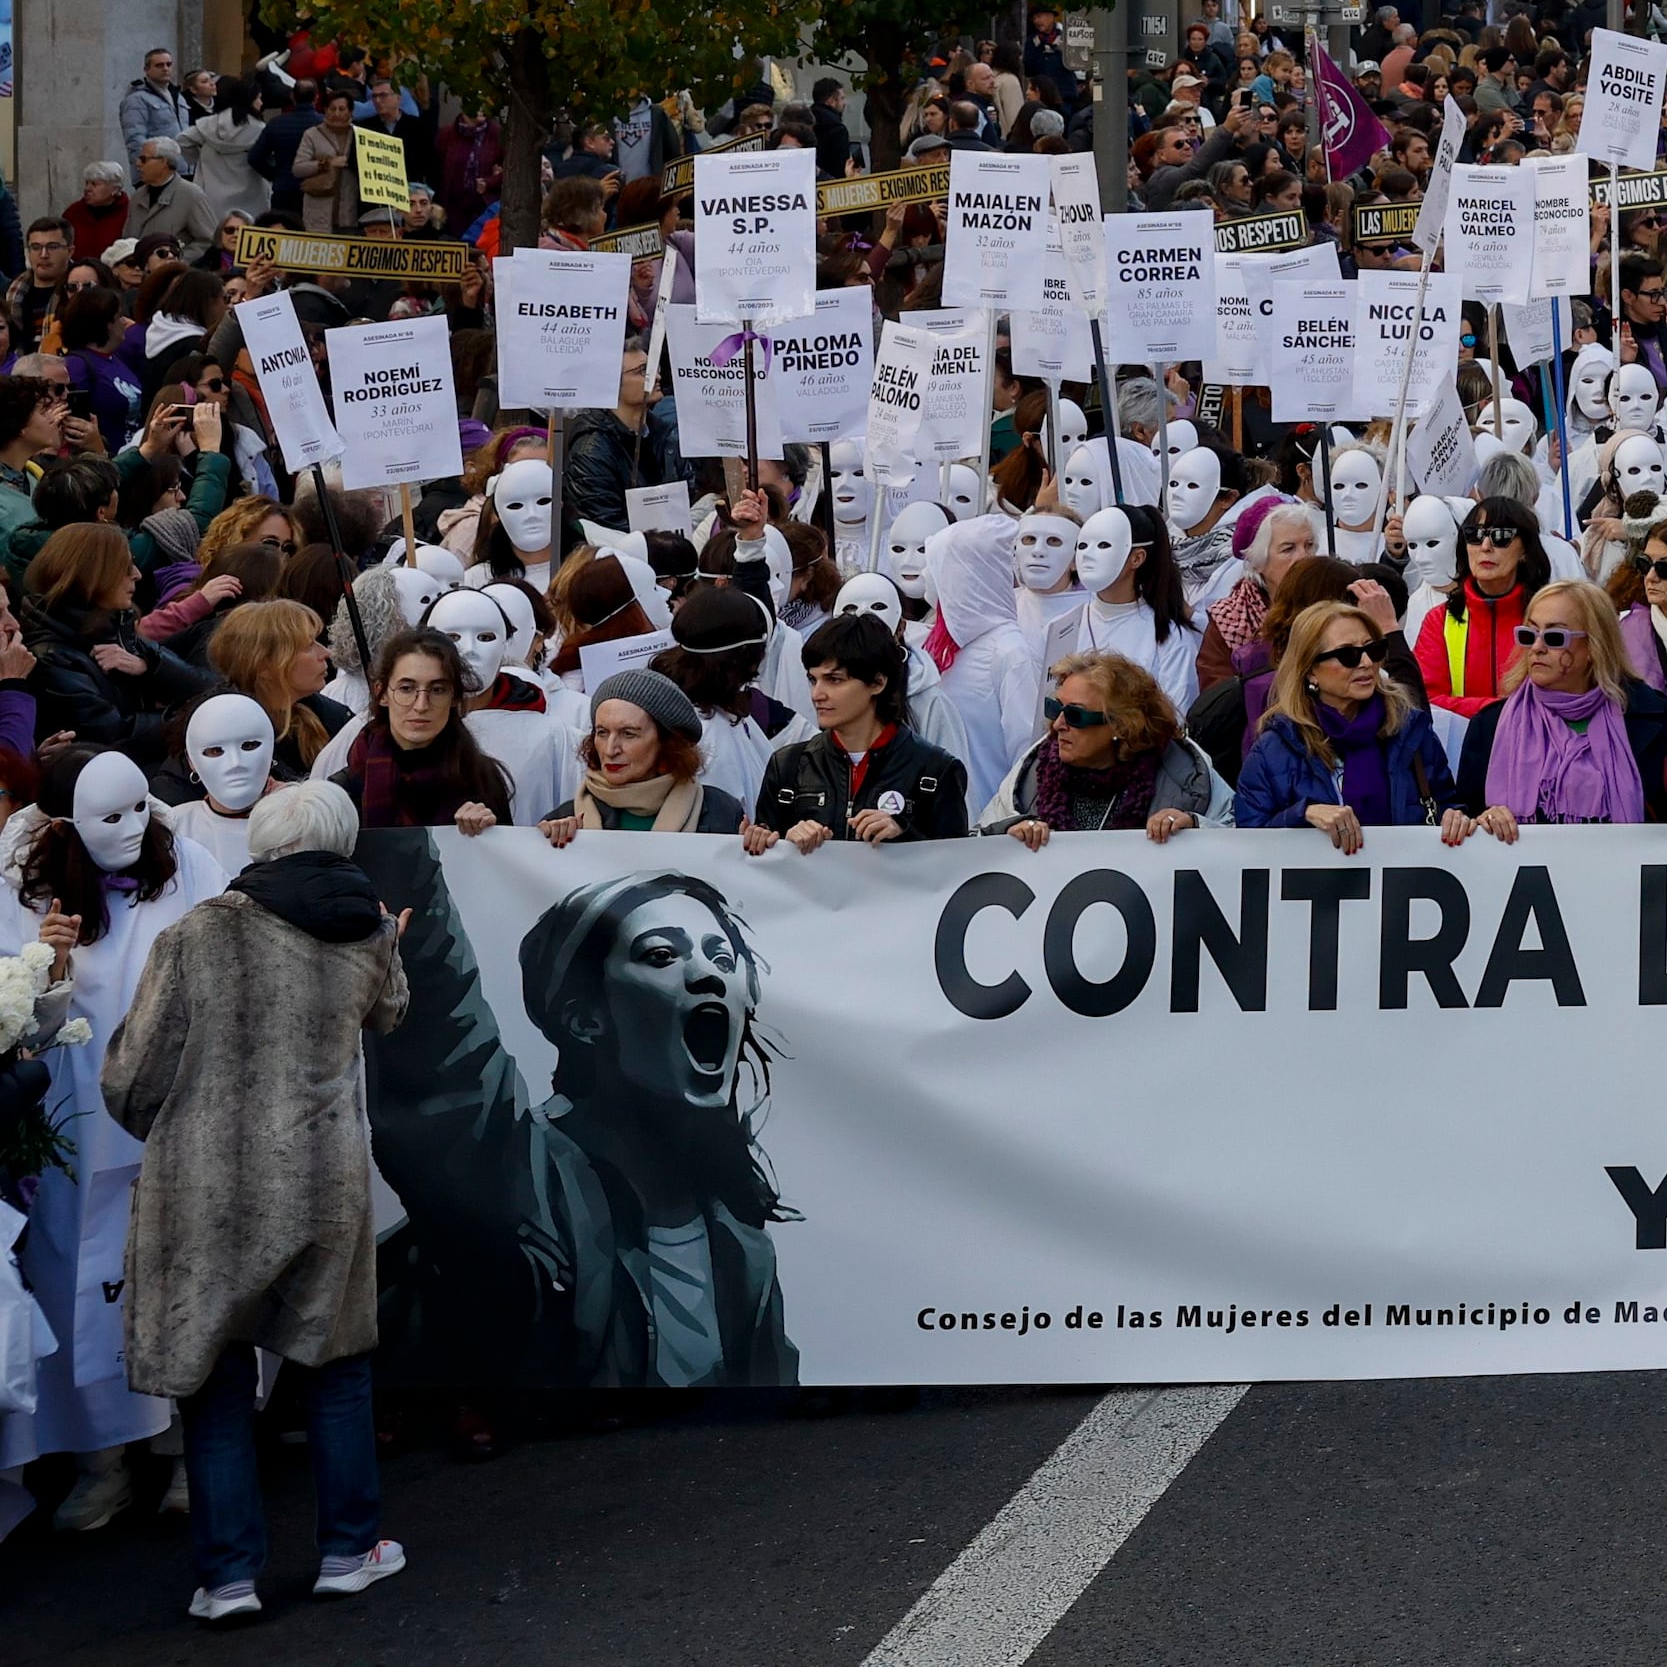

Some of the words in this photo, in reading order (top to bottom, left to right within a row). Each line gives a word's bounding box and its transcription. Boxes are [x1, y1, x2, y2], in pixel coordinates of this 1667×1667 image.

[1602, 63, 1656, 89] ABDILE
[1600, 79, 1654, 106] YOSITE
[701, 194, 808, 216] VANESSA
[955, 193, 1041, 212] MAIALEN
[1458, 198, 1517, 211] MARICEL
[732, 218, 775, 234] S.P.
[961, 210, 1032, 232] MAZÓN
[1461, 209, 1513, 223] GARCÍA
[1460, 224, 1516, 236] VALMEO
[246, 235, 276, 261] LAS
[279, 238, 345, 268] MUJERES
[346, 245, 409, 272] EXIGIMOS
[411, 250, 462, 274] RESPETO
[728, 242, 744, 254] 44
[748, 241, 780, 254] años
[1117, 247, 1201, 264] CARMEN
[1119, 265, 1201, 282] CORREA
[518, 302, 617, 320] ELISABETH
[773, 332, 863, 355] PALOMA
[782, 352, 859, 372] PINEDO
[364, 362, 421, 384] NOEMÍ
[344, 378, 443, 403] RODRÍGUEZ
[934, 866, 1588, 1020] CONTRA
[916, 1305, 1052, 1337] Consejo
[1064, 1304, 1104, 1330] de
[1116, 1304, 1163, 1329] las
[1175, 1303, 1310, 1335] Mujeres
[1321, 1303, 1373, 1327] del
[1385, 1301, 1551, 1331] Municipio
[1563, 1300, 1601, 1325] de
